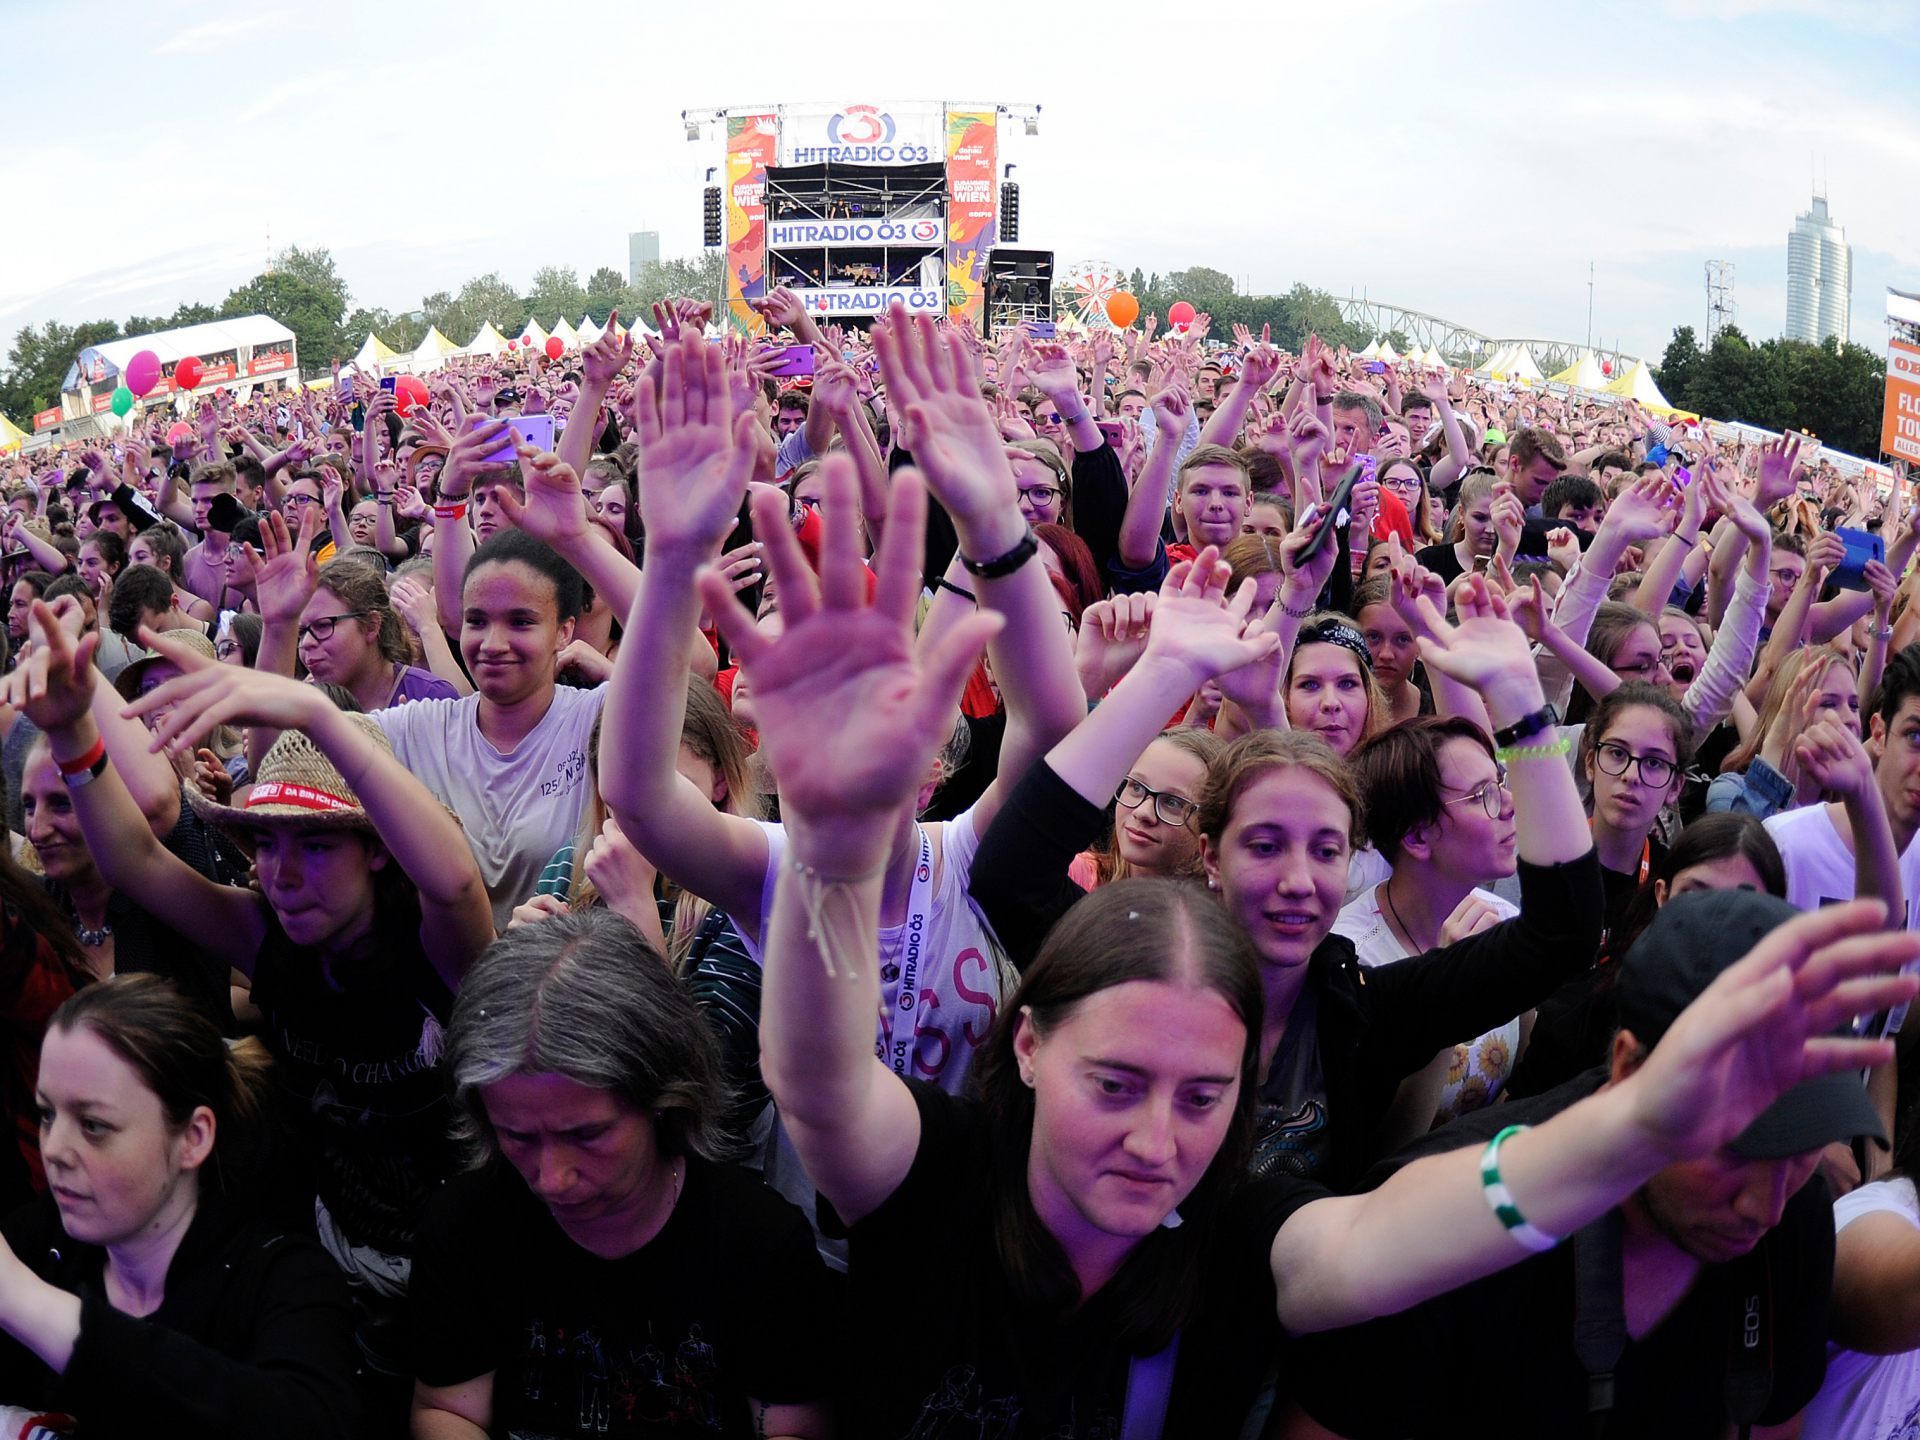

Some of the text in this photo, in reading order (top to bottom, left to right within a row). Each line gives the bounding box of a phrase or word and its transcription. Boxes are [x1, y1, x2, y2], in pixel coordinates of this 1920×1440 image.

[794, 142, 929, 163] HITRADIO Ö3
[733, 194, 761, 207] WIE
[953, 191, 991, 203] WIEN
[773, 224, 874, 243] HITRADIO
[877, 219, 907, 241] Ö3
[909, 288, 938, 308] Ö3
[298, 790, 315, 800] BIN
[315, 794, 331, 805] ICH
[903, 913, 924, 991] HITRADIO Ö3
[893, 1040, 907, 1057] Ö3
[1744, 1294, 1761, 1349] EOS
